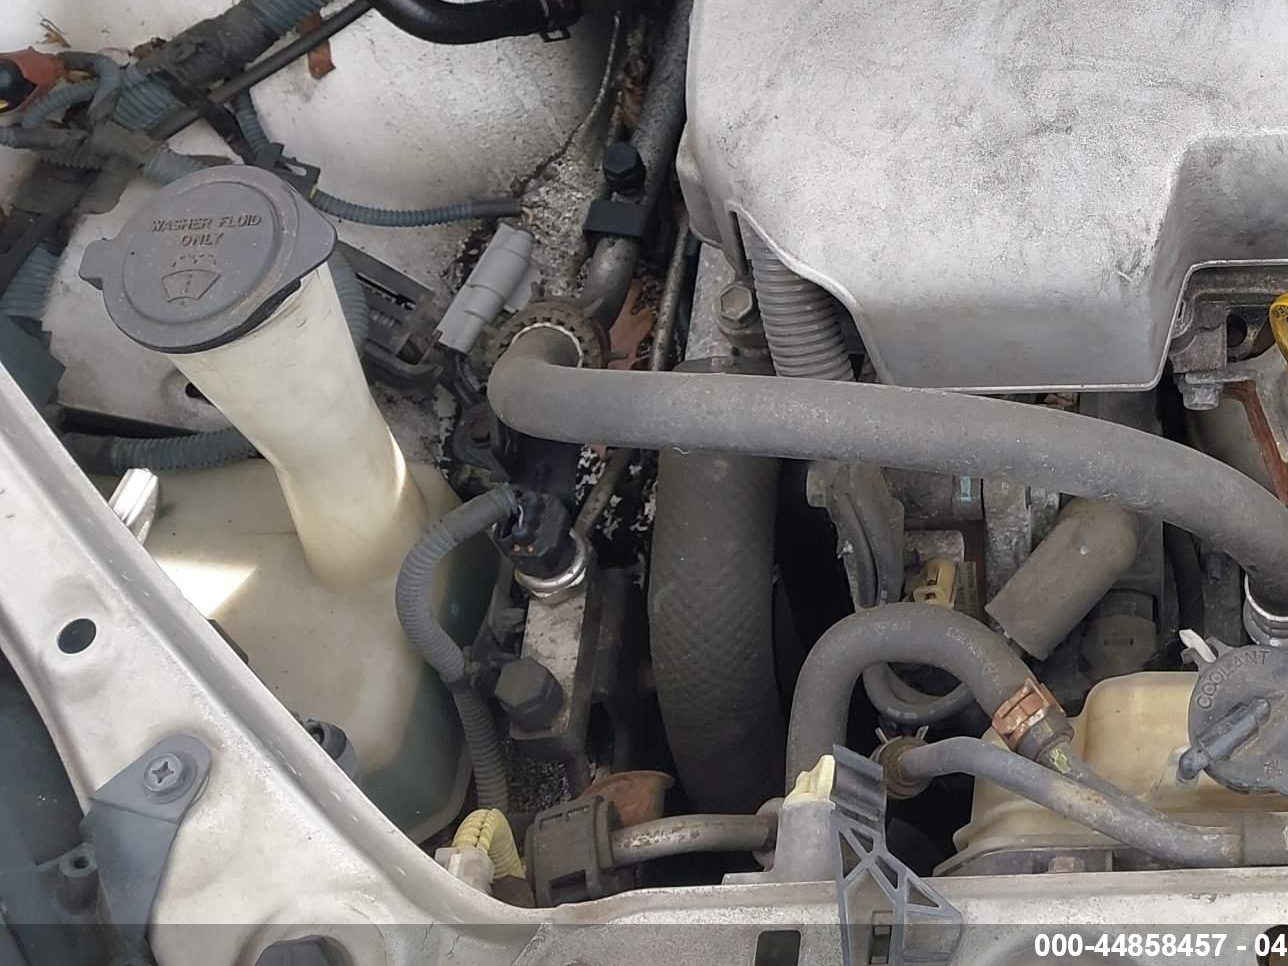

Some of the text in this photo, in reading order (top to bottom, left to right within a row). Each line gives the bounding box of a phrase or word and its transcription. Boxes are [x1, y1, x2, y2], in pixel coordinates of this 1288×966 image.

[151, 214, 262, 232] WASHER FLUID
[180, 232, 223, 246] ONLY
[1195, 650, 1271, 710] COOLANT
